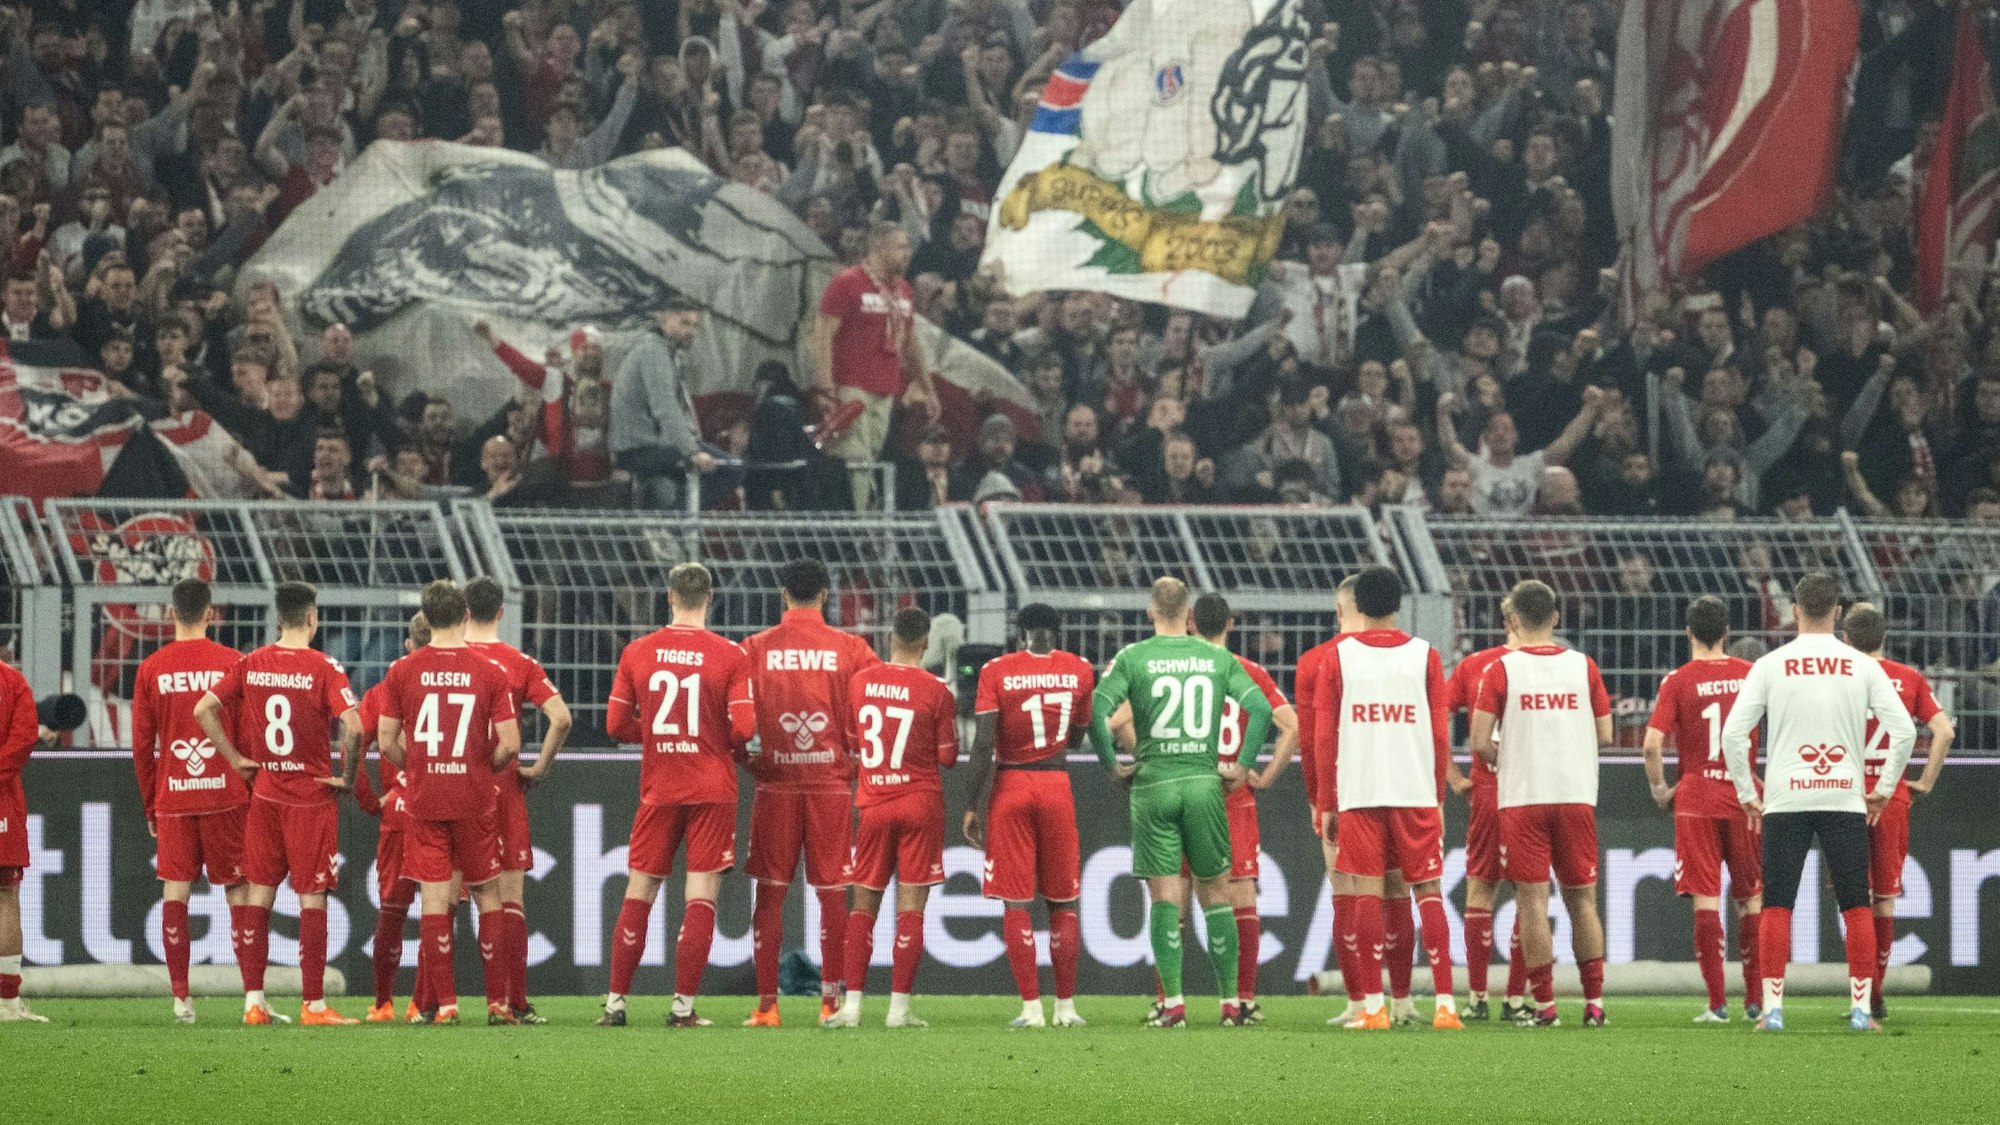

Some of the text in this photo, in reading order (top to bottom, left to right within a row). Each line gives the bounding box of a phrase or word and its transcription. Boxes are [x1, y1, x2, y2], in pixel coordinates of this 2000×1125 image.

[656, 649, 703, 666] TIGGES
[767, 649, 838, 672] REWE
[1147, 656, 1216, 674] SCHWÄBE
[1784, 657, 1853, 676] REWE
[247, 670, 313, 690] HUSEINBAŠIĆ
[421, 672, 470, 688] OLESEN
[1003, 674, 1078, 691] SCHINDLER
[865, 682, 909, 701] MAINA
[649, 671, 700, 737] 21
[1150, 675, 1214, 739] 20
[1520, 693, 1579, 711] REWE
[1021, 691, 1073, 750] 17
[1352, 703, 1416, 724] REWE
[265, 694, 294, 756] 8
[414, 693, 476, 758] 47
[1218, 695, 1241, 755] 8
[858, 704, 915, 769] 37
[676, 740, 699, 754] KÖLN
[774, 747, 836, 765] hummel
[1182, 741, 1207, 754] KÖLN
[446, 761, 467, 774] KÖLN
[168, 774, 226, 792] hummel
[1790, 778, 1853, 790] hummel
